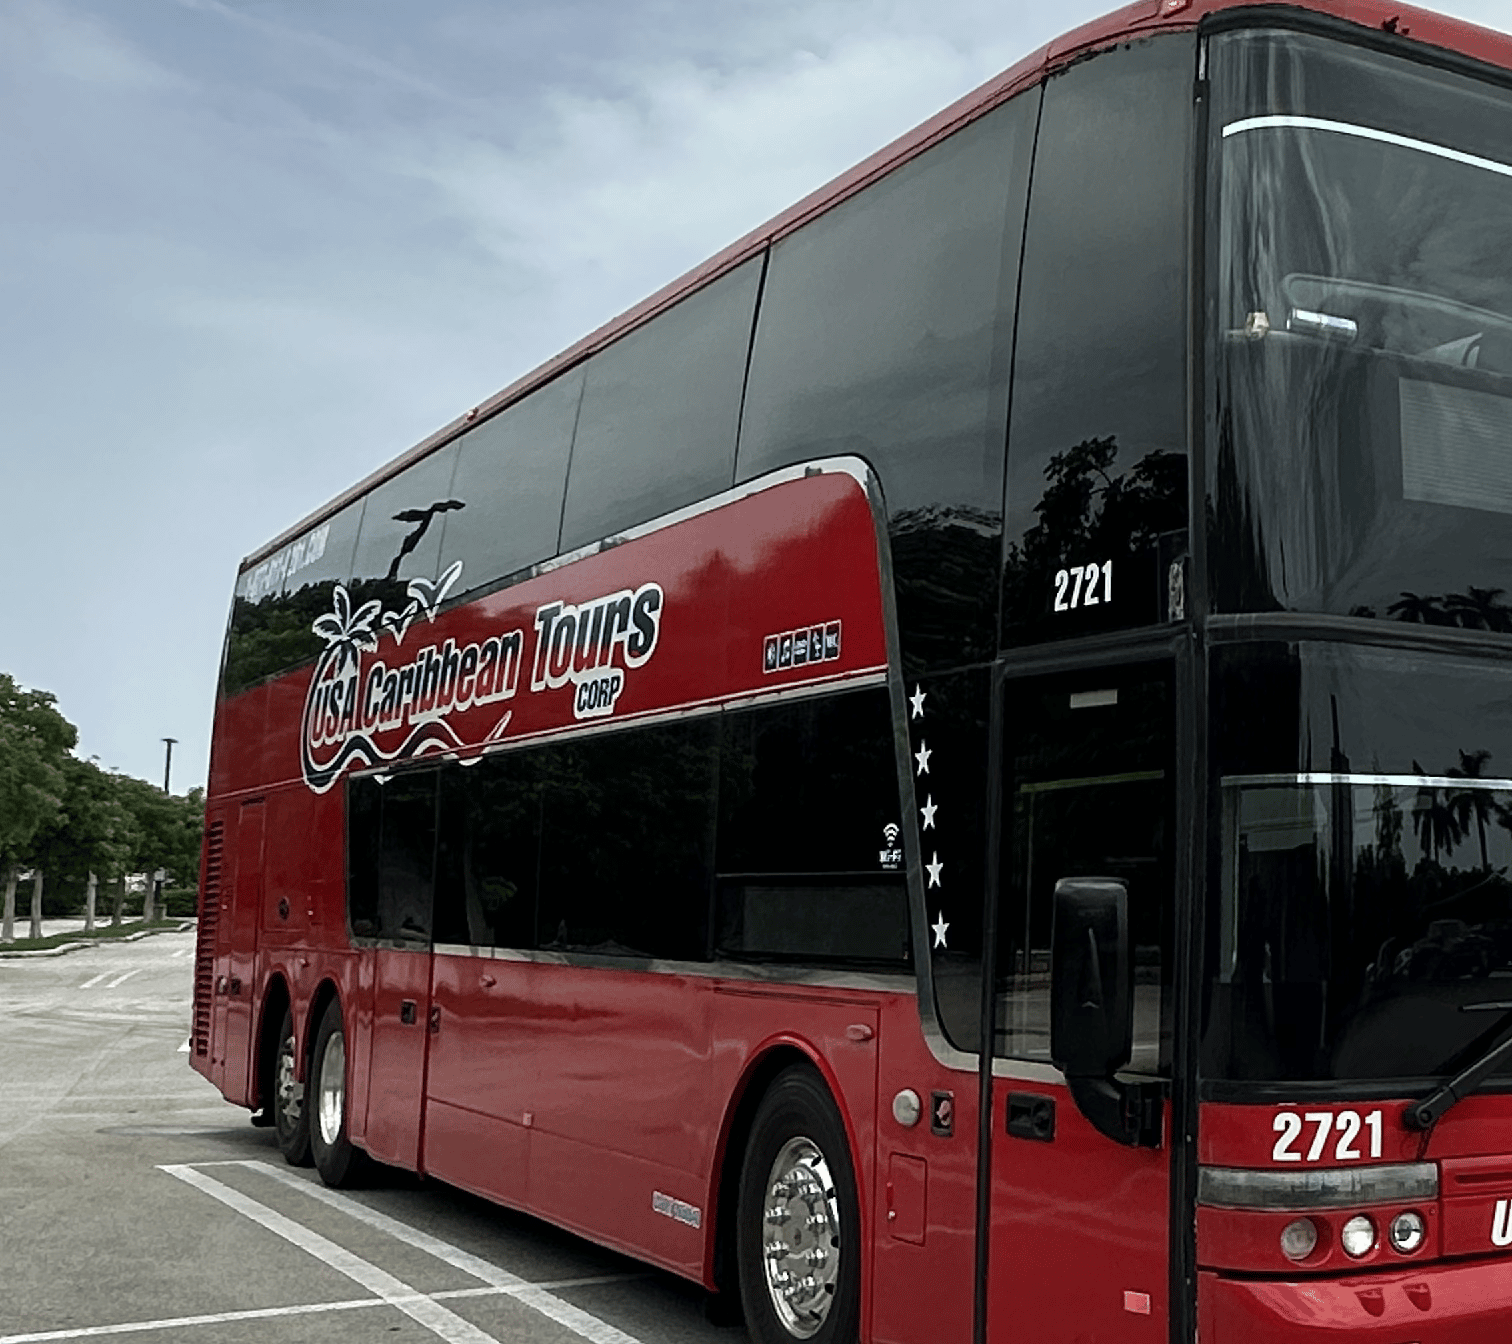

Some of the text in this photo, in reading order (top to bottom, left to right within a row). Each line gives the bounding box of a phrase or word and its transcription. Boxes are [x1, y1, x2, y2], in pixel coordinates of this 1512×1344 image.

[1054, 559, 1112, 612] 2721
[311, 585, 662, 747] USA Caribbean Tours
[577, 674, 621, 713] CORP
[1272, 1110, 1382, 1162] 2721
